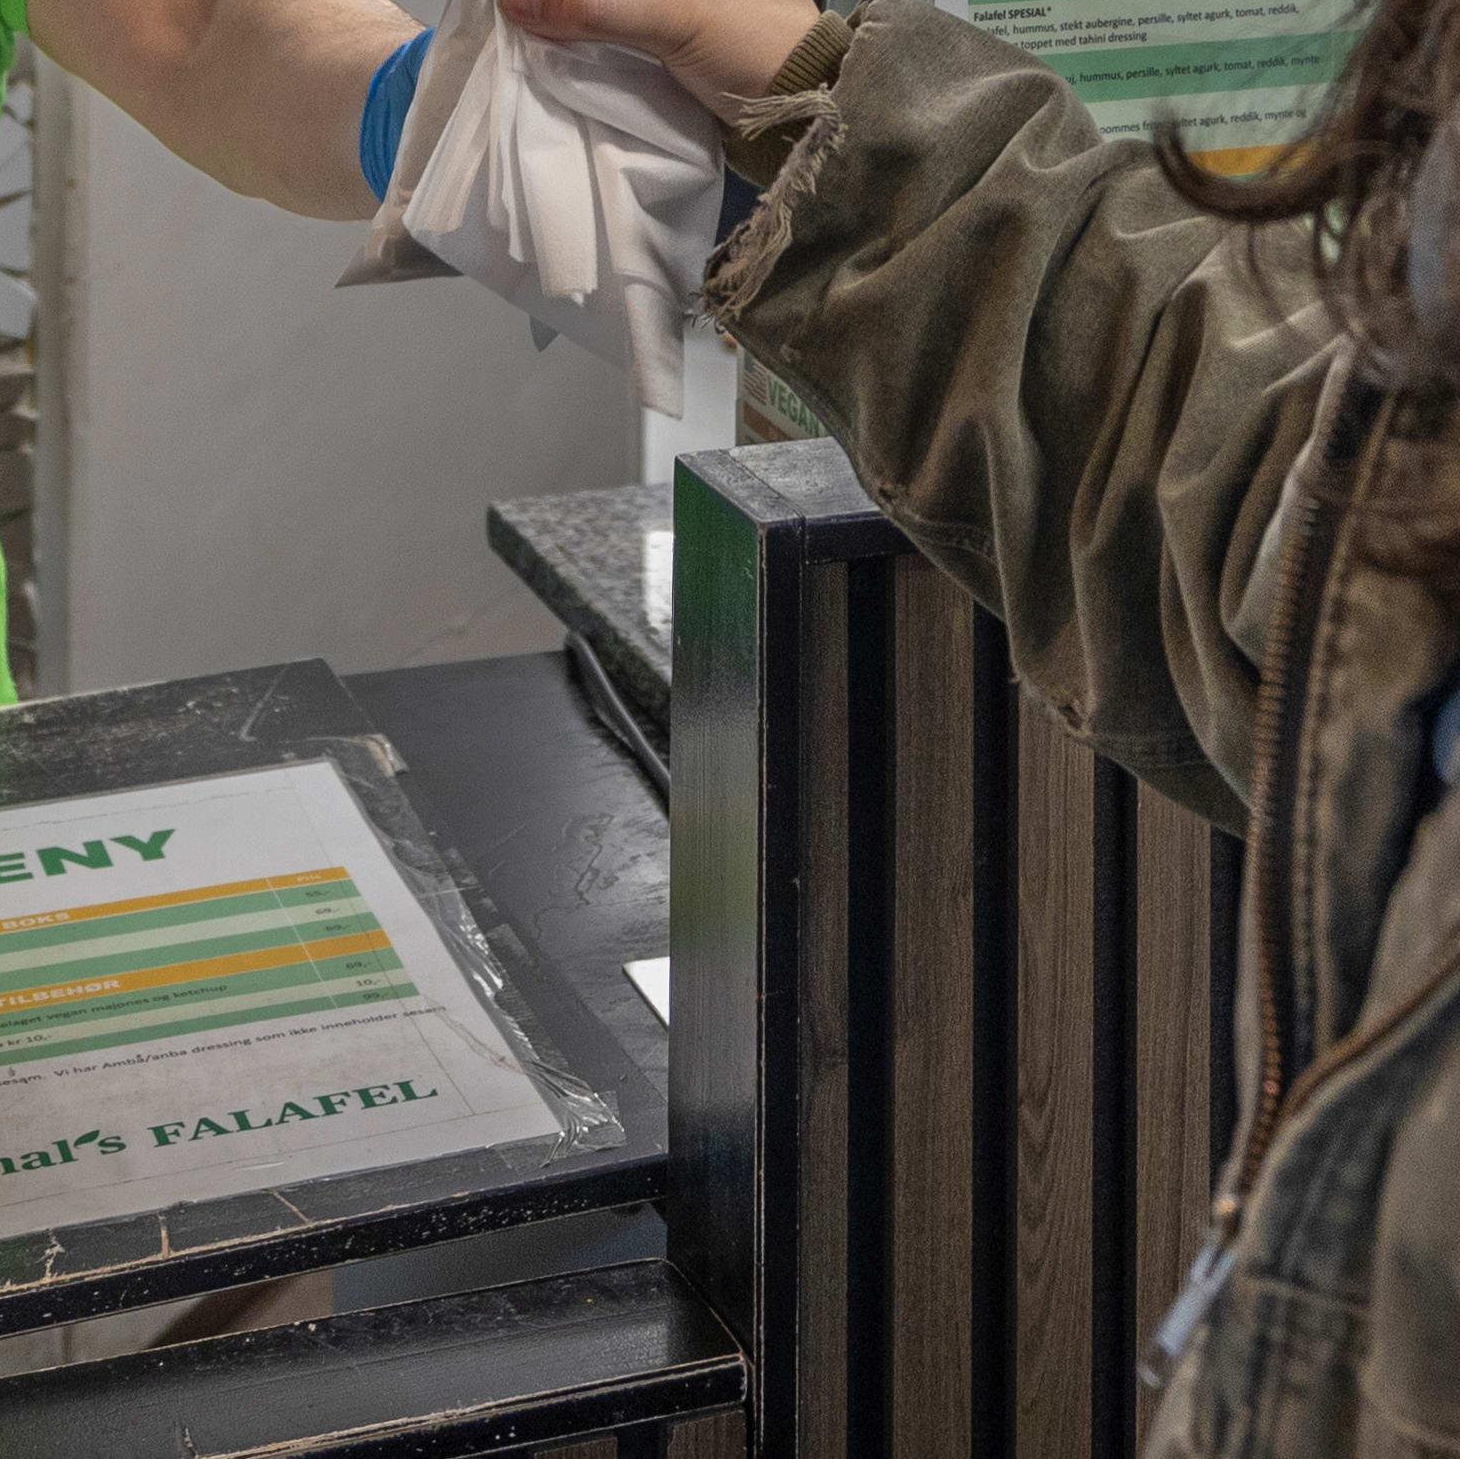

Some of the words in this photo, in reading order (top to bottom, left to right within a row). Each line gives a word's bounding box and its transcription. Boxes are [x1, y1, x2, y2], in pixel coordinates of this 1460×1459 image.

[974, 10, 1006, 21] Falafel
[1059, 21, 1082, 30] stekt
[1176, 11, 1202, 24] syltet
[1021, 38, 1052, 51] toppet
[1055, 37, 1076, 46] med
[1078, 34, 1105, 44] tahini
[1108, 31, 1146, 45] dressing
[1200, 115, 1228, 127] agurk,
[0, 912, 70, 930] BOKS
[72, 1063, 99, 1074] har
[254, 1033, 287, 1042] som
[288, 1026, 319, 1036] ikke
[147, 1077, 439, 1147] FALAFEL
